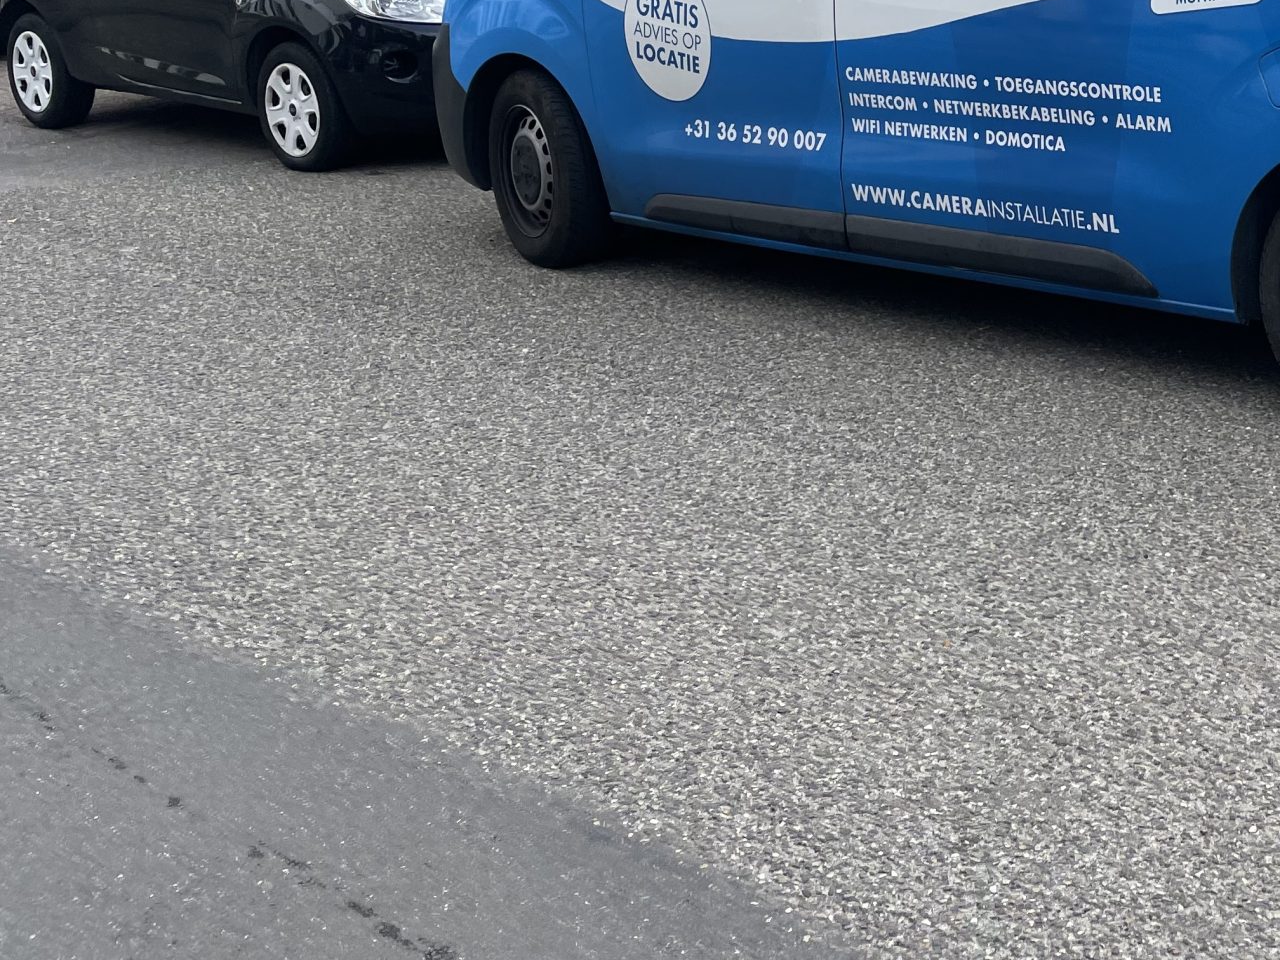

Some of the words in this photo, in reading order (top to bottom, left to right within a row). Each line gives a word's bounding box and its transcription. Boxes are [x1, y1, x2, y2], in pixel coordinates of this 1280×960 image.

[633, 20, 679, 46] ADVIES
[682, 32, 702, 51] OP
[636, 41, 700, 74] LOCATIE
[845, 66, 978, 90] CAMERABEWAKING
[994, 76, 1162, 103] TOEGANGSCONTROLE
[848, 92, 918, 112] INTERCOM
[933, 98, 1096, 127] NETWERKBEKABELING
[1115, 113, 1172, 133] ALARM
[684, 119, 710, 139] +31
[717, 121, 738, 142] 36
[742, 124, 762, 144] 52
[767, 127, 789, 148] 90
[793, 130, 827, 152] 007
[852, 117, 881, 135] WIFI
[884, 120, 968, 143] NETWERKEN
[985, 129, 1066, 152] DOMOTICA
[851, 183, 1121, 234] WWW.CAMERAINSTALLATIE.NL
